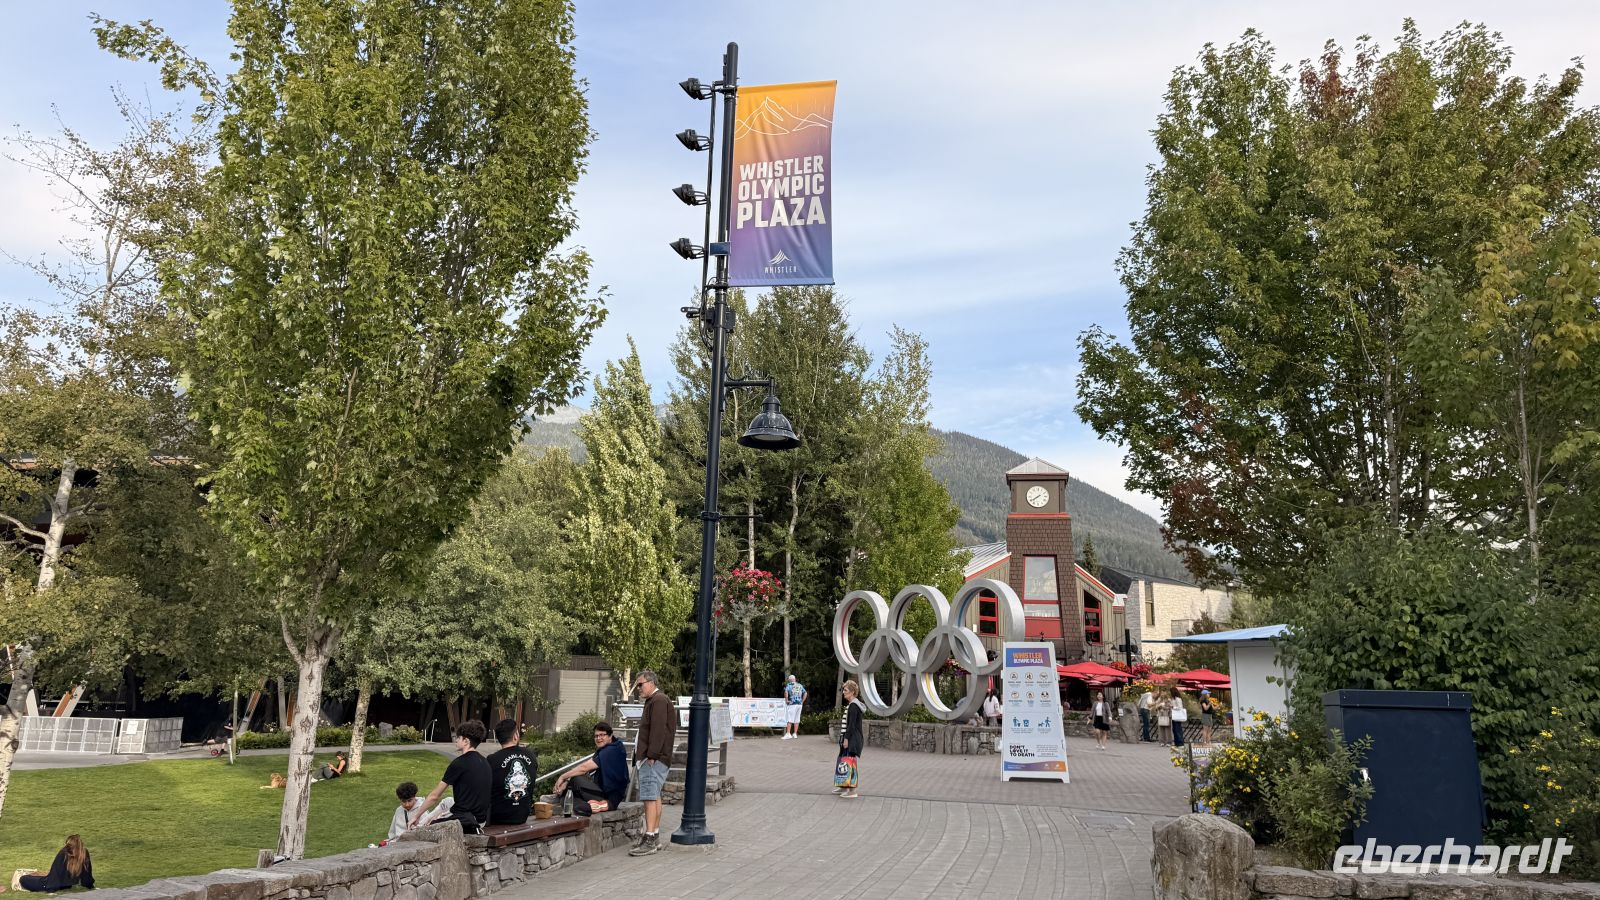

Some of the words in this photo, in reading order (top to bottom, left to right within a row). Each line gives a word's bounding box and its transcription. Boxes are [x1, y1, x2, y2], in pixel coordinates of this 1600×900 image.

[740, 155, 824, 180] WHISTLER
[738, 173, 825, 201] OLYMPIC
[736, 196, 826, 230] PLAZA
[764, 266, 797, 274] WHISTLER
